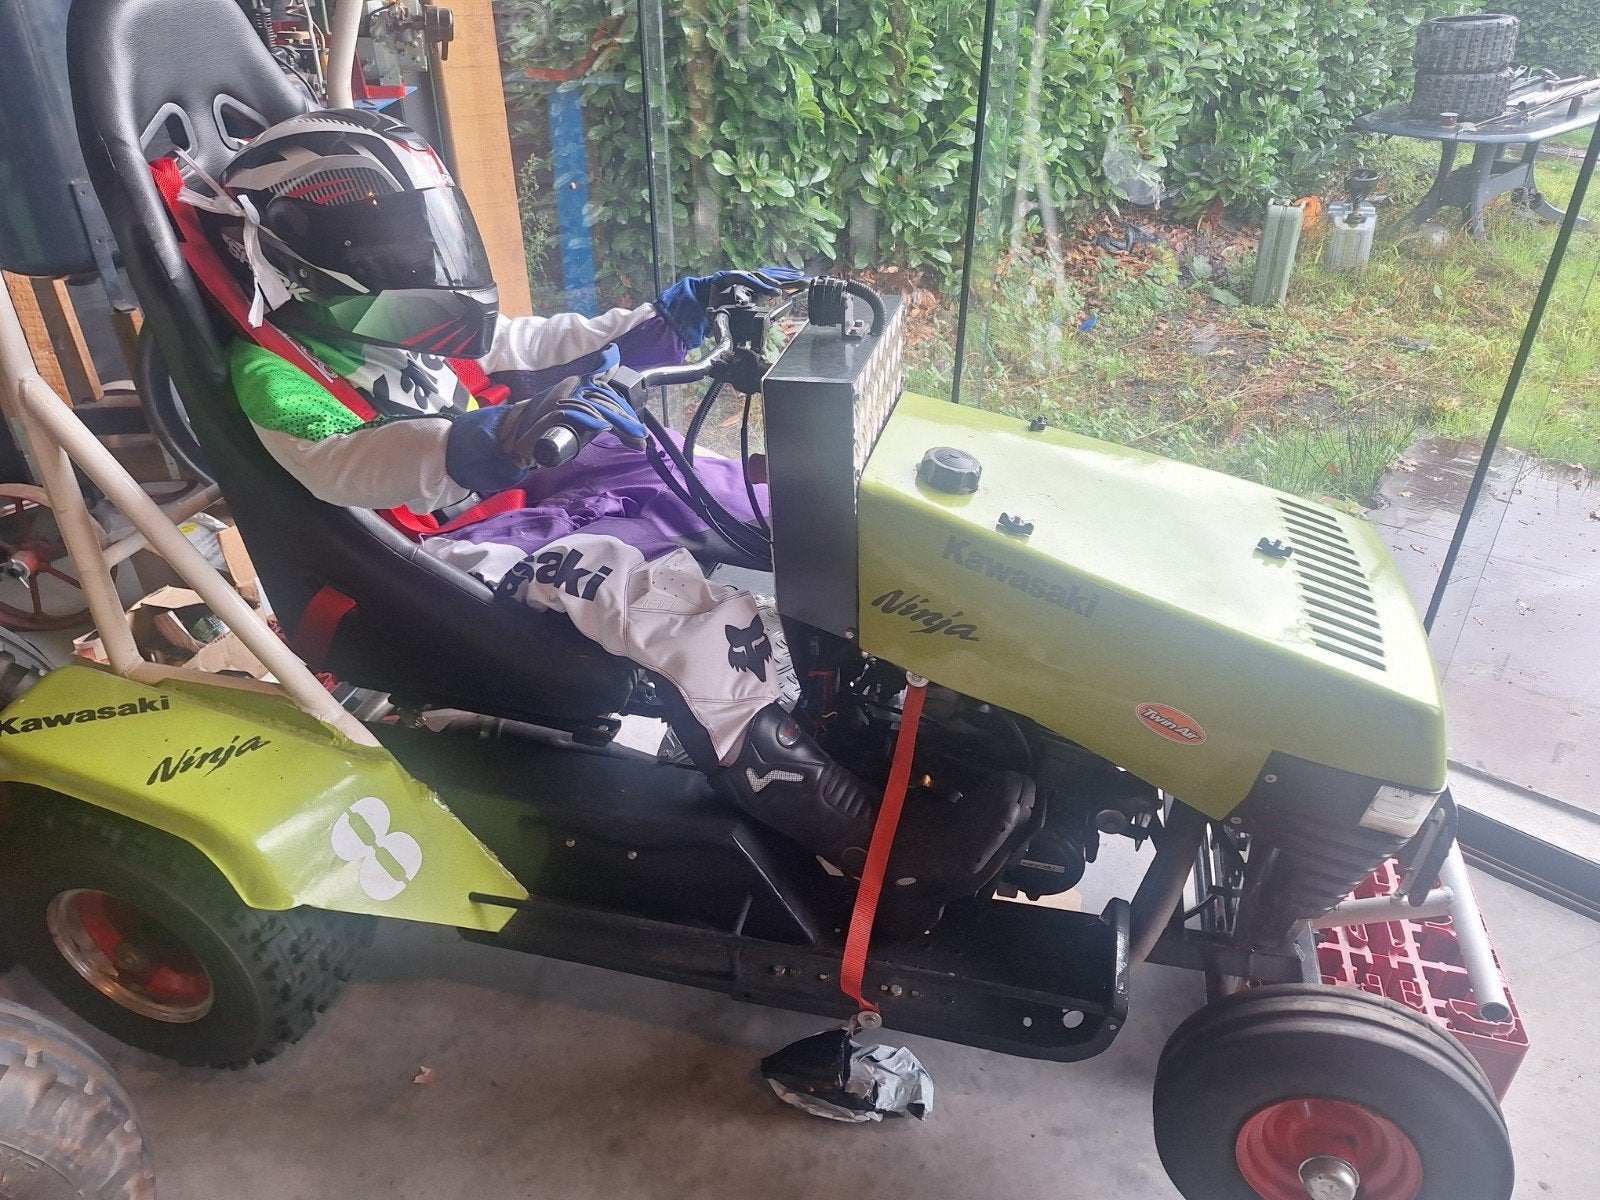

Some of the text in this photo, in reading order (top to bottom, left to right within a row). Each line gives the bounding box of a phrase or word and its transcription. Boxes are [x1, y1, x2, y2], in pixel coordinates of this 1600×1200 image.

[942, 534, 1100, 618] Kawasaki
[871, 589, 980, 642] Ninja
[0, 695, 170, 737] Kawasaki
[1141, 708, 1201, 740] Twin Air
[146, 735, 271, 786] Ninja
[331, 796, 423, 901] 8
